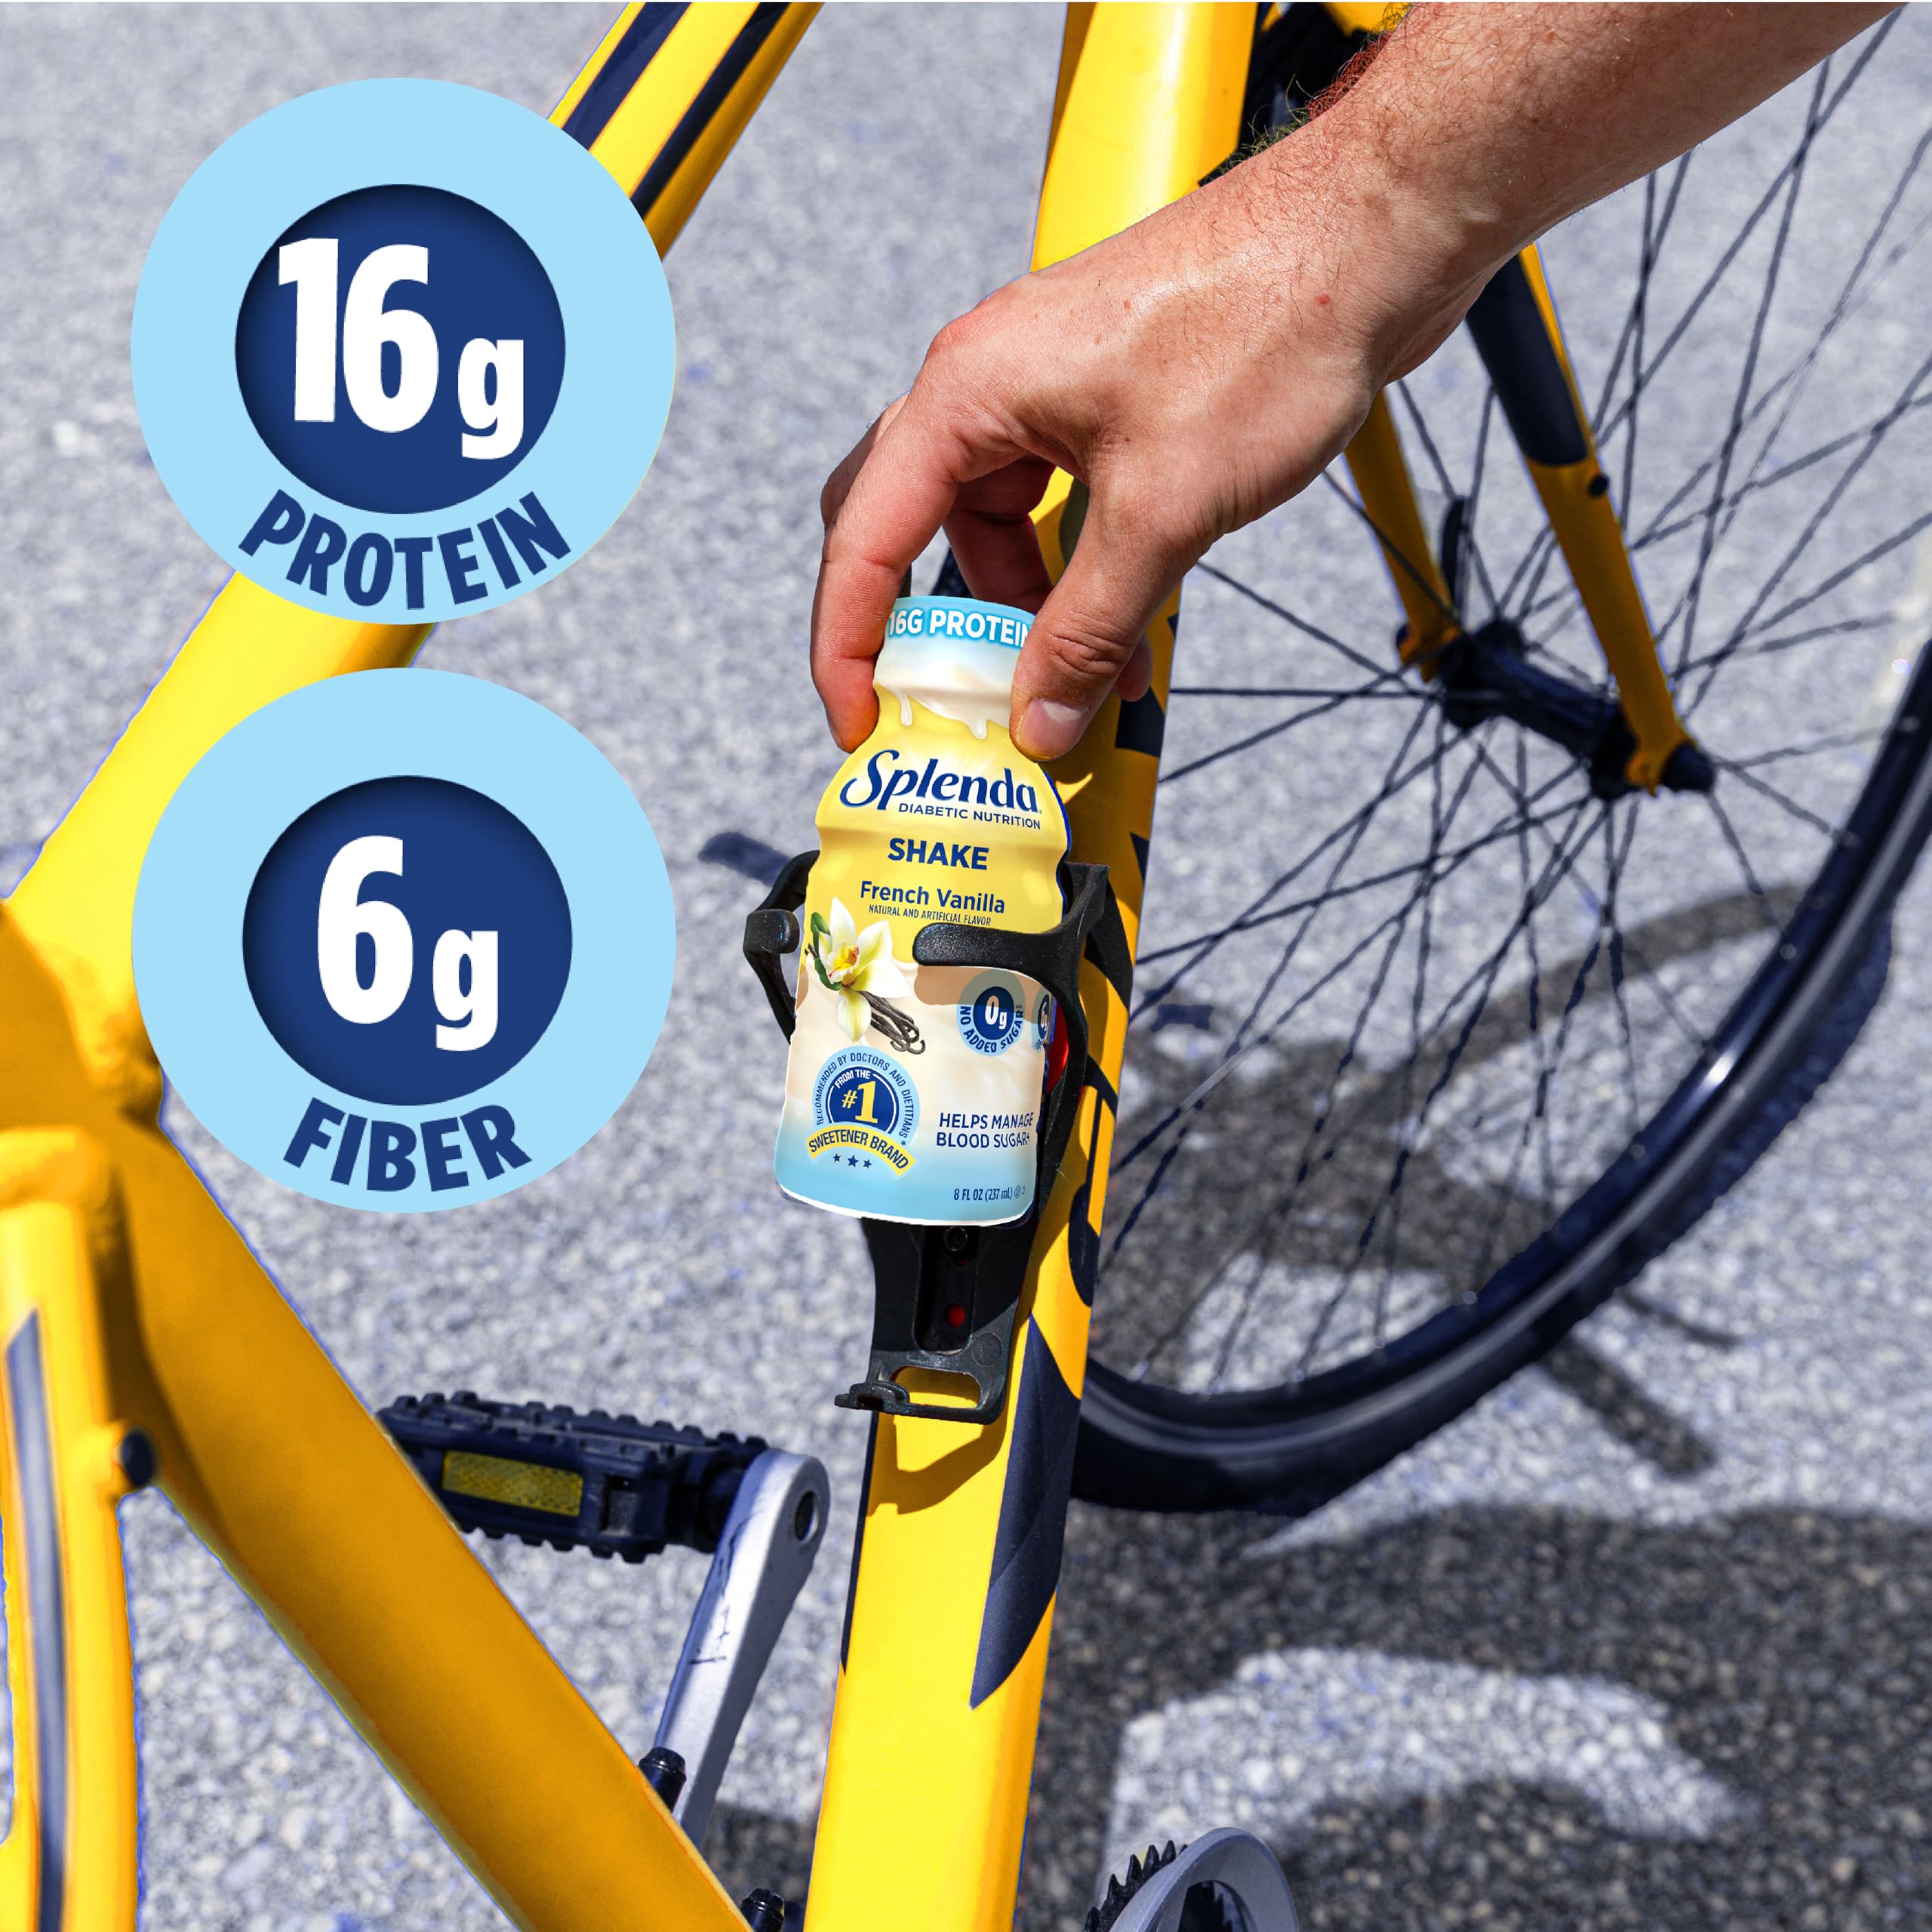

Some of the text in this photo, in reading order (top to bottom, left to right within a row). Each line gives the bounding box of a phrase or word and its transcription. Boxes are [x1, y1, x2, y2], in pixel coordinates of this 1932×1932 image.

[888, 609, 923, 635] 16G
[899, 803, 1041, 829] DIABETIC NUTRITION
[888, 837, 990, 870] SHAKE
[860, 881, 1004, 914] French Vanilla
[869, 904, 991, 926] NATURAL AND ARTIFICIAL FLAVOR
[960, 1006, 971, 1026] NO
[964, 1029, 997, 1053] ADDED
[815, 1062, 837, 1125] RECOMMENDED
[838, 1055, 847, 1066] BY
[850, 1053, 890, 1071] DOCTORS
[889, 1069, 906, 1087] AND
[834, 1069, 871, 1089] FROM THE
[841, 1081, 878, 1124] #1
[939, 1112, 1034, 1129] HELPS MANAGE
[809, 1129, 909, 1169] SWEETENER BRAND
[937, 1131, 989, 1148] BLOOD
[954, 1189, 959, 1201] 8
[961, 1189, 971, 1200] FL
[973, 1189, 983, 1201] OZ
[985, 1188, 1000, 1201] (237
